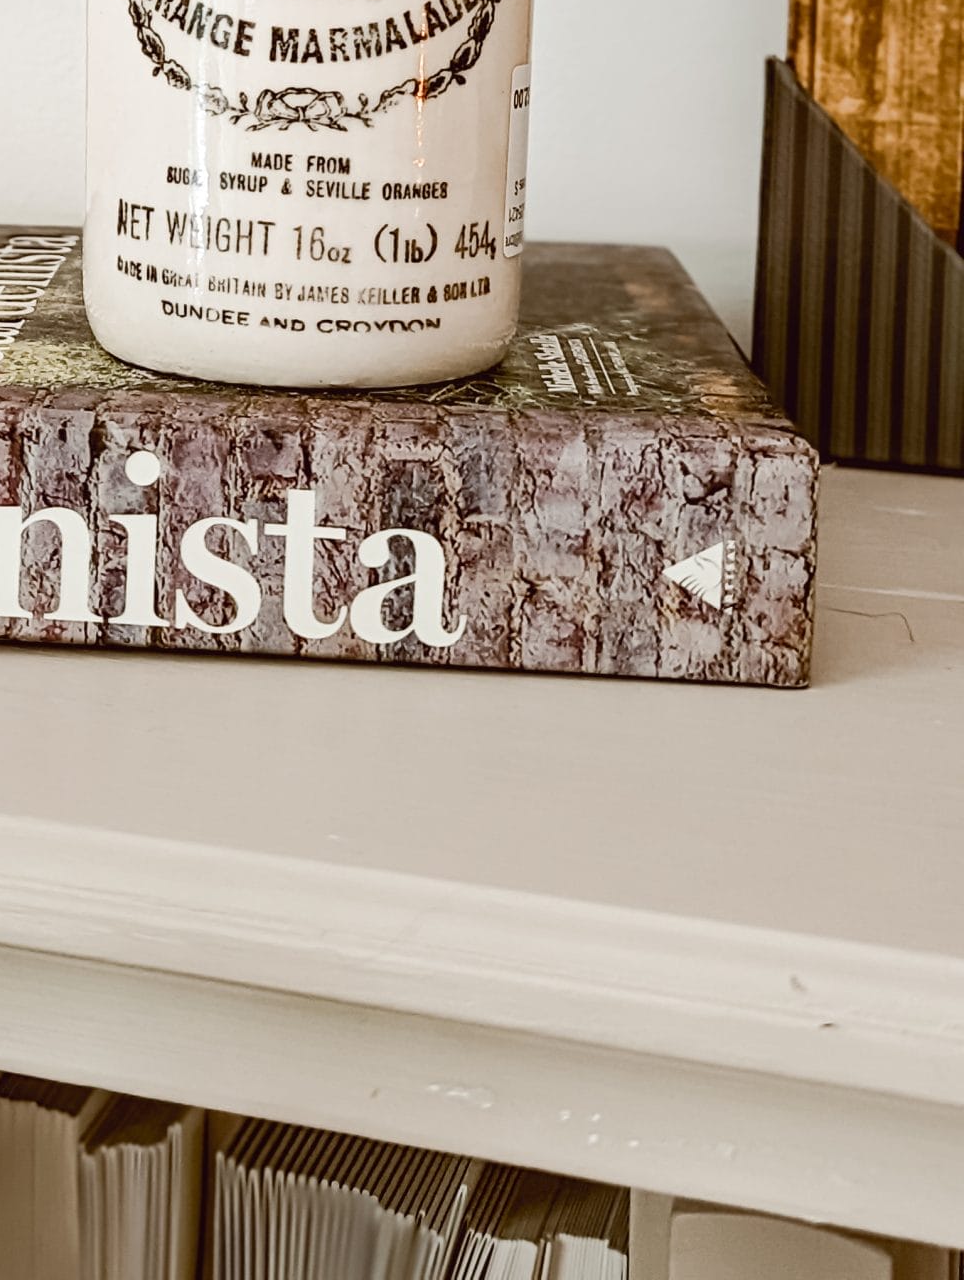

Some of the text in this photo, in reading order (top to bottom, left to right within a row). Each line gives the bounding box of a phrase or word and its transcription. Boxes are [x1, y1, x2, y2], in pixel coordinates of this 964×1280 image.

[250, 152, 351, 175] MADE FROM
[219, 171, 269, 194] SYRUP
[280, 177, 293, 196] &
[305, 179, 372, 201] SEVILLE
[382, 181, 449, 201] ORANGES
[116, 198, 155, 241] NET
[166, 209, 276, 256] WEIGHT
[292, 224, 352, 265] 16oz
[146, 263, 158, 284] IN
[208, 275, 267, 298] BRITAIN
[274, 282, 293, 301] BY
[296, 285, 350, 305] JAMES
[356, 285, 421, 306] KEILLER
[160, 299, 251, 327] DUNDEE
[259, 316, 306, 333] AND
